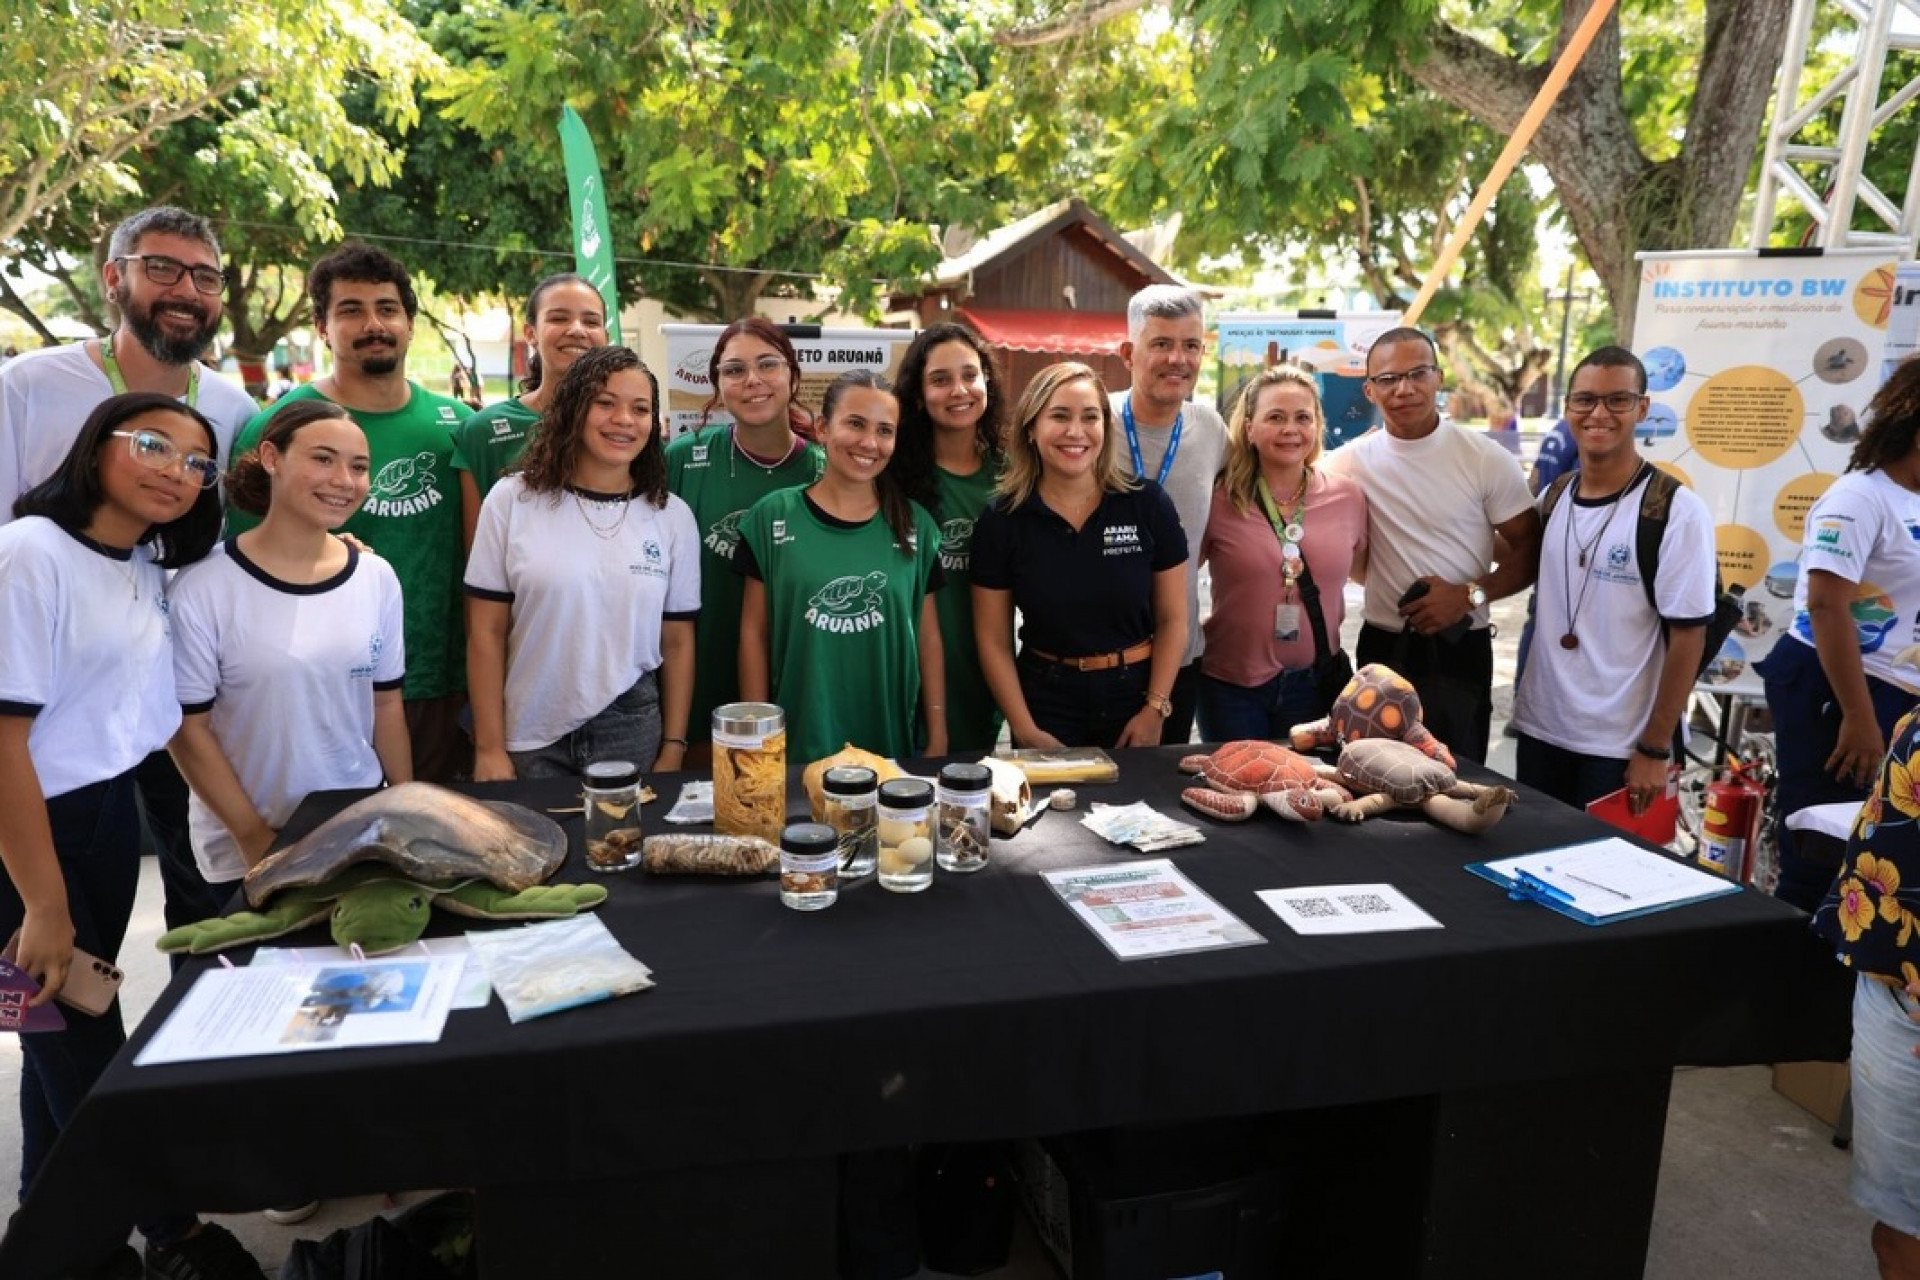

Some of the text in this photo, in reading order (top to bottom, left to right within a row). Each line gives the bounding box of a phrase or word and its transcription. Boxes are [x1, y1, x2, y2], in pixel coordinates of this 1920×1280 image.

[1654, 279, 1847, 298] INSTITUTO BW
[828, 346, 884, 364] ARUANÃ
[362, 485, 443, 518] ARUANÃ
[804, 605, 885, 634] ARUANÃ
